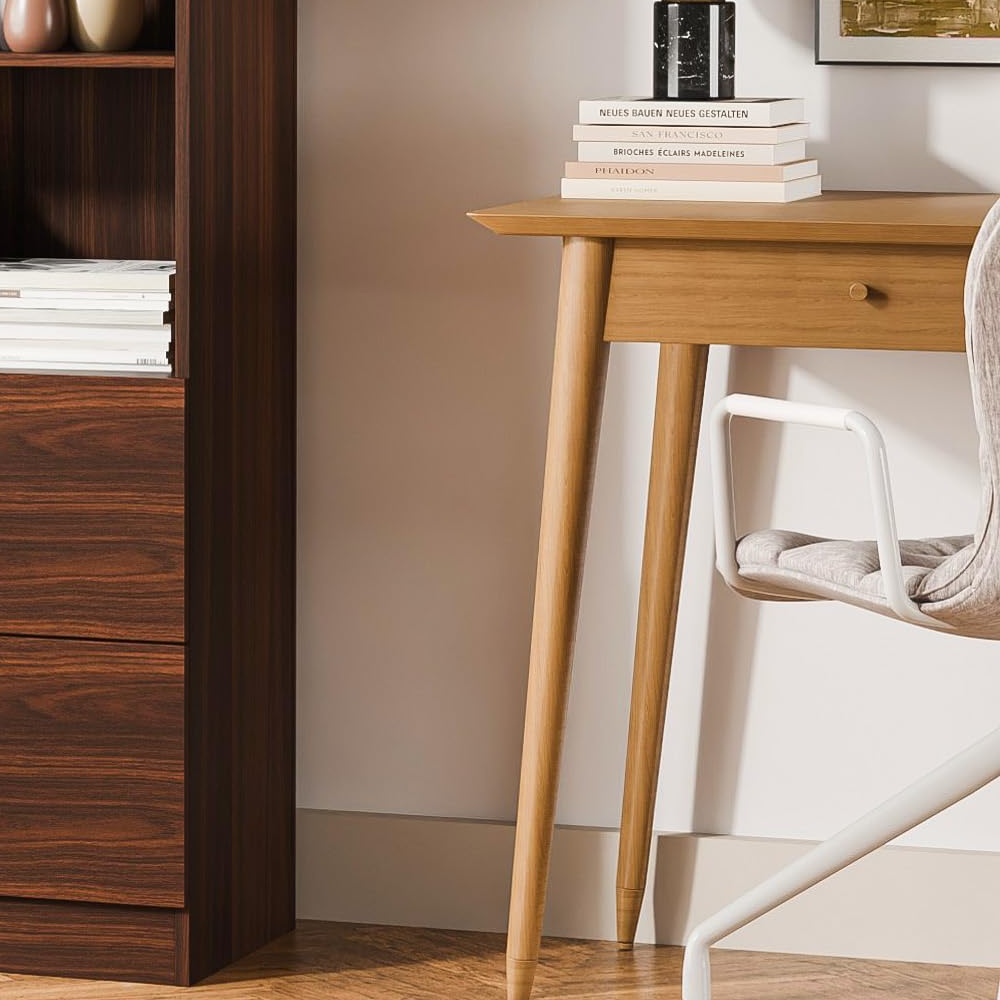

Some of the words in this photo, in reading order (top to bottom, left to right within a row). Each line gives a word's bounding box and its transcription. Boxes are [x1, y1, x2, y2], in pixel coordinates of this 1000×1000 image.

[599, 108, 630, 118] NEUES
[632, 108, 663, 118] BAUEN
[665, 109, 696, 118] NEUES
[698, 109, 749, 119] GESTALTEN
[631, 130, 654, 139] SAN
[657, 130, 724, 139] FRANCISCO
[613, 148, 655, 157] BRIOCHES
[657, 147, 692, 158] ÉCLAIRS
[693, 149, 746, 159] MADELEINES
[595, 167, 655, 175] PHAIDON
